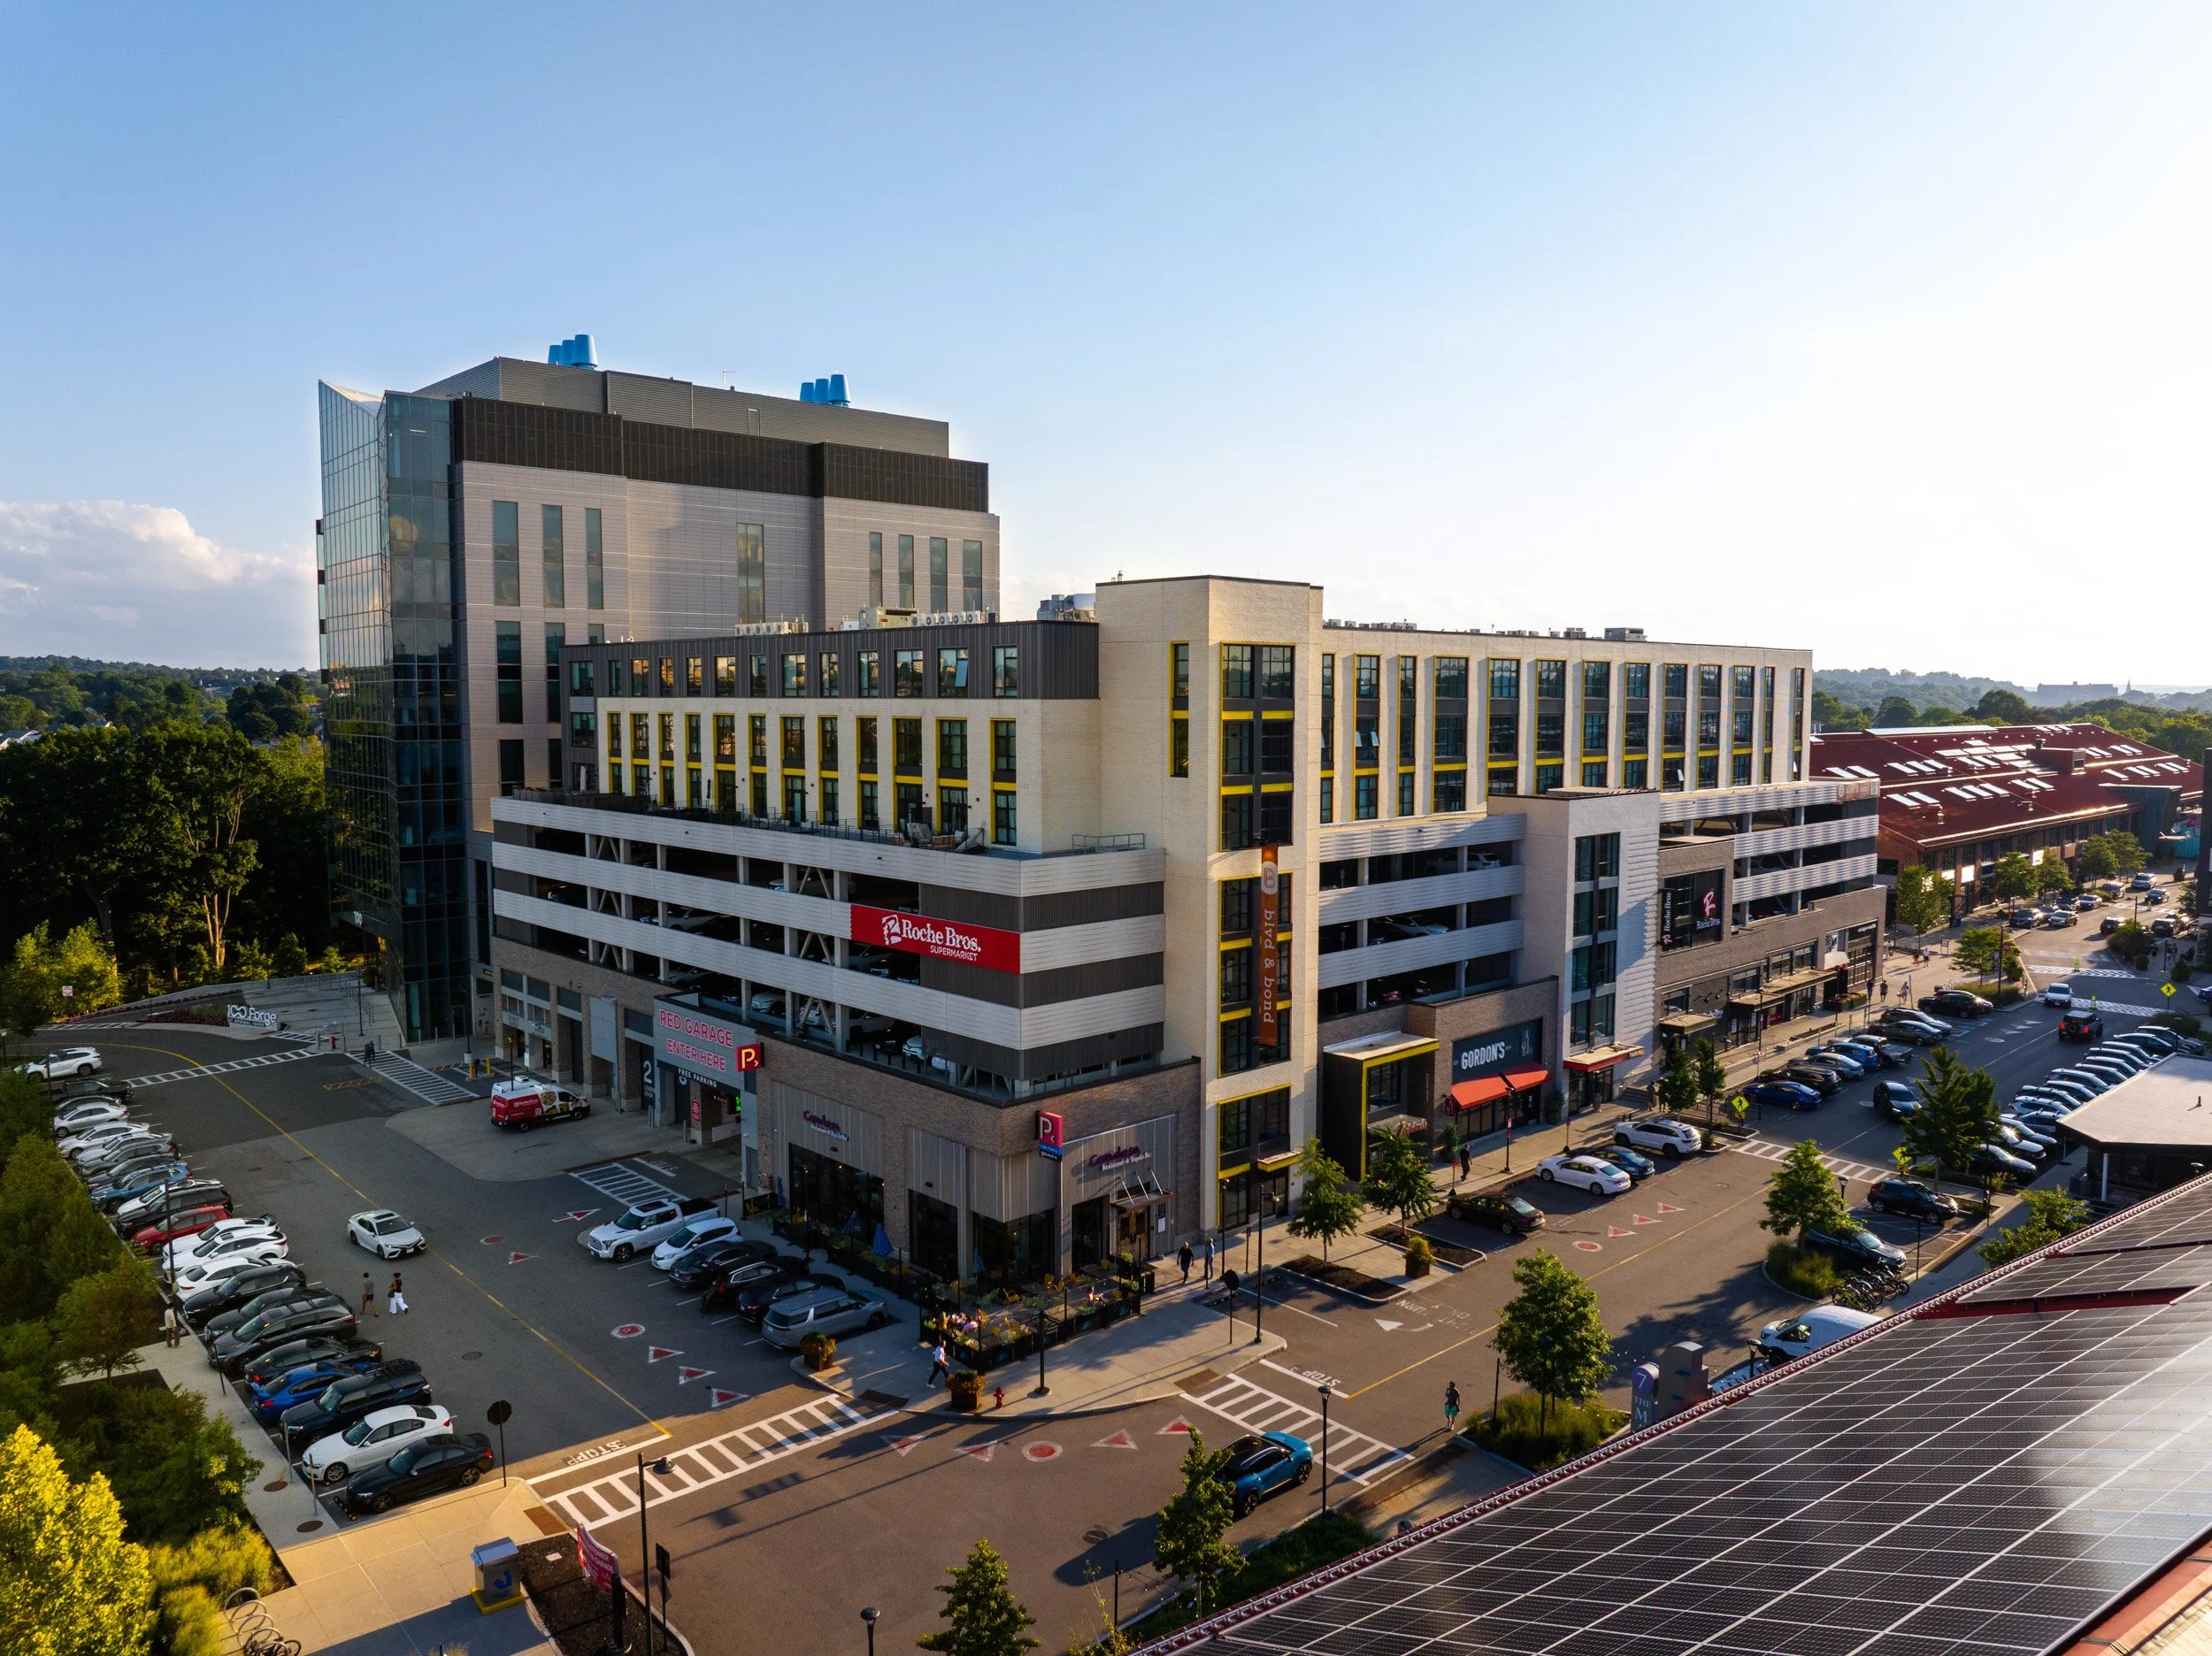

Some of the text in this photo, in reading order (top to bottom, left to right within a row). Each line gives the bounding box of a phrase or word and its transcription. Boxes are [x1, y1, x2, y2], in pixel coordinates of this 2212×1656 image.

[901, 918, 982, 953] Roche Bros.
[930, 945, 979, 962] SUPERMARKET
[1264, 909, 1275, 1024] blvd & bond
[249, 1007, 277, 1026] Forge
[659, 1008, 733, 1048] RED GARAGE
[666, 1038, 726, 1072] ENTER HERE
[741, 1048, 756, 1069] P
[1461, 1041, 1505, 1070] GORDON'S
[643, 1060, 652, 1084] 2
[678, 1068, 692, 1079] FREE
[693, 1073, 718, 1088] PARKING
[1040, 1116, 1053, 1139] P
[1302, 1370, 1341, 1387] STOP
[1637, 1372, 1647, 1389] 7
[1633, 1395, 1651, 1408] THE
